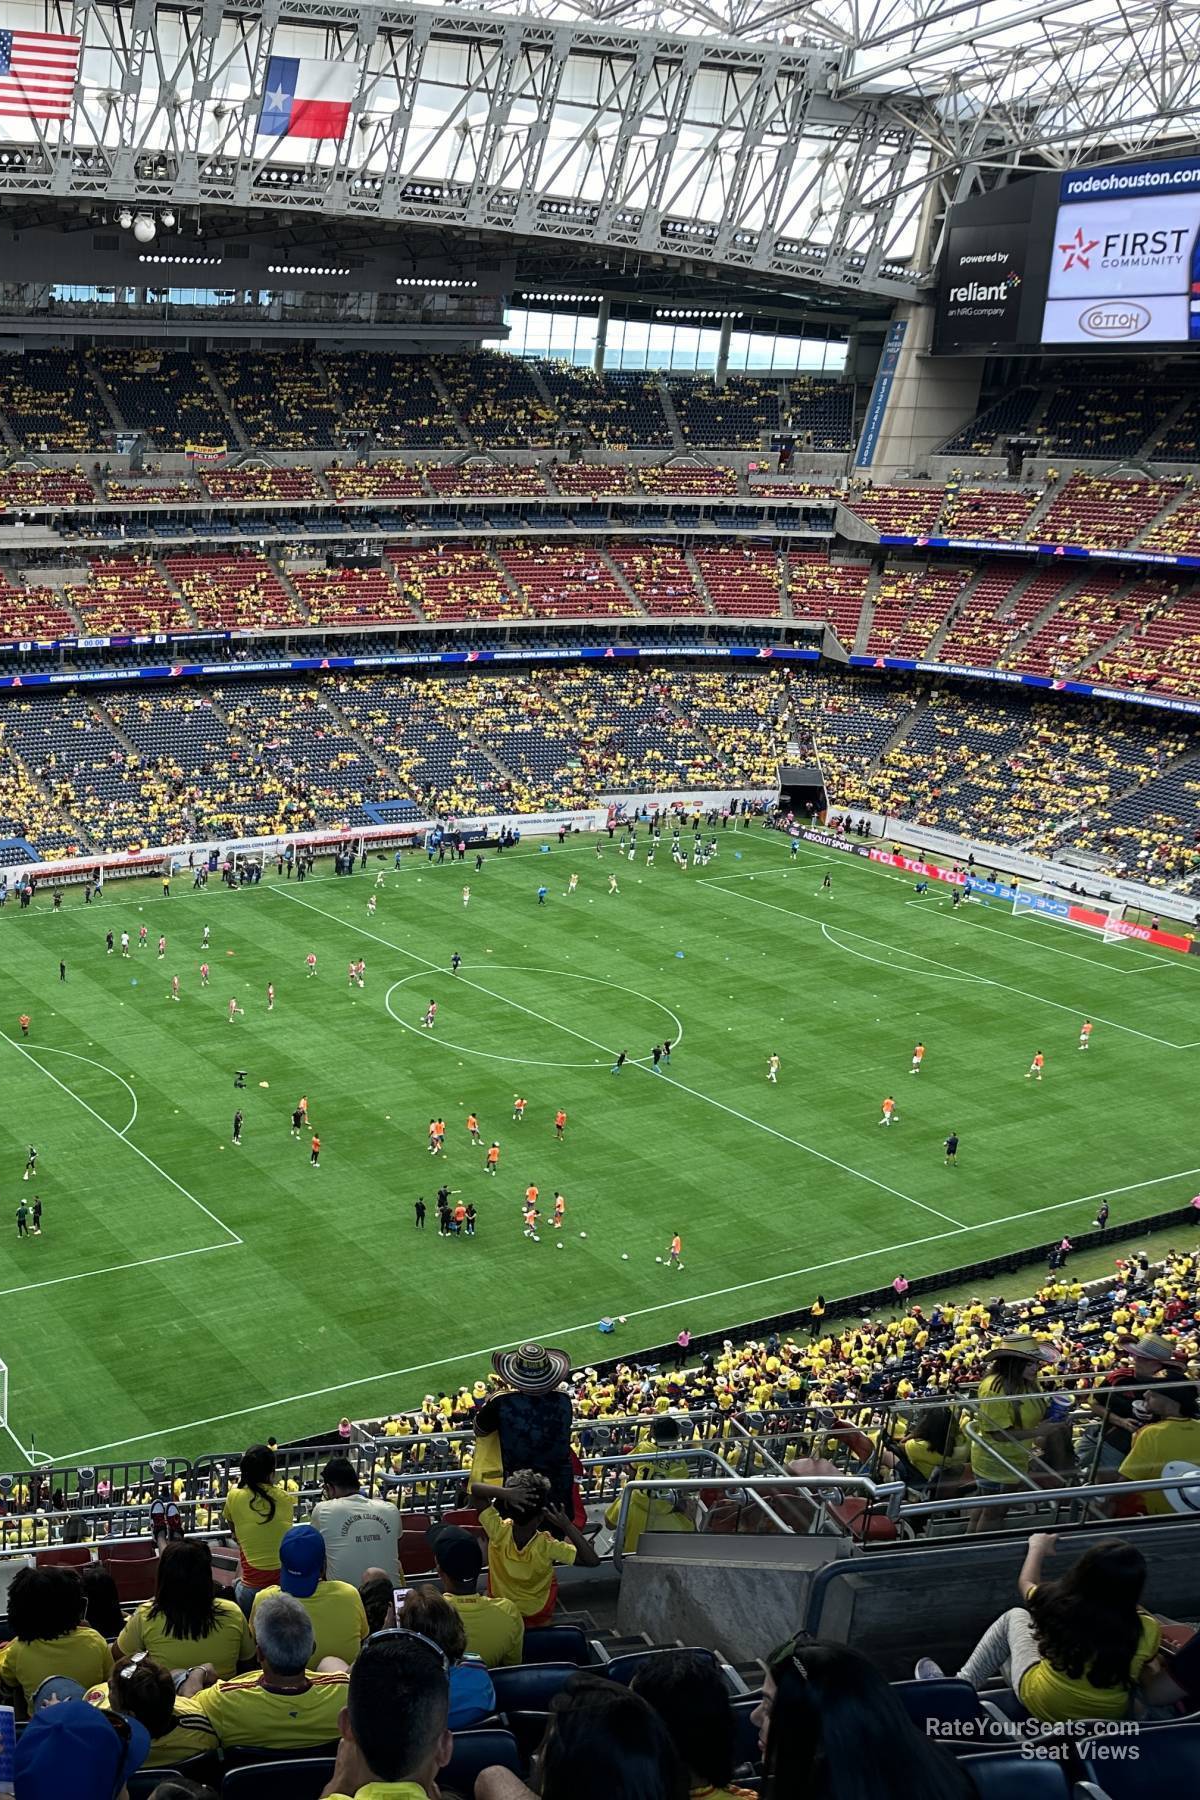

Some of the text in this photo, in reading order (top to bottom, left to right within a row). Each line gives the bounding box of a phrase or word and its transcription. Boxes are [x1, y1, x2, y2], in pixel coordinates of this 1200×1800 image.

[1103, 229, 1189, 257] FIRST
[960, 252, 1009, 265] powered by
[1101, 255, 1183, 268] COMMUNITY
[950, 282, 1007, 301] reliant
[973, 307, 1005, 318] company
[803, 832, 832, 845] ABSOLUT
[832, 840, 854, 852] SPORT
[871, 849, 898, 866] TCL
[903, 859, 930, 876] TCL
[937, 868, 966, 885] TCL
[1036, 898, 1068, 914] BYD
